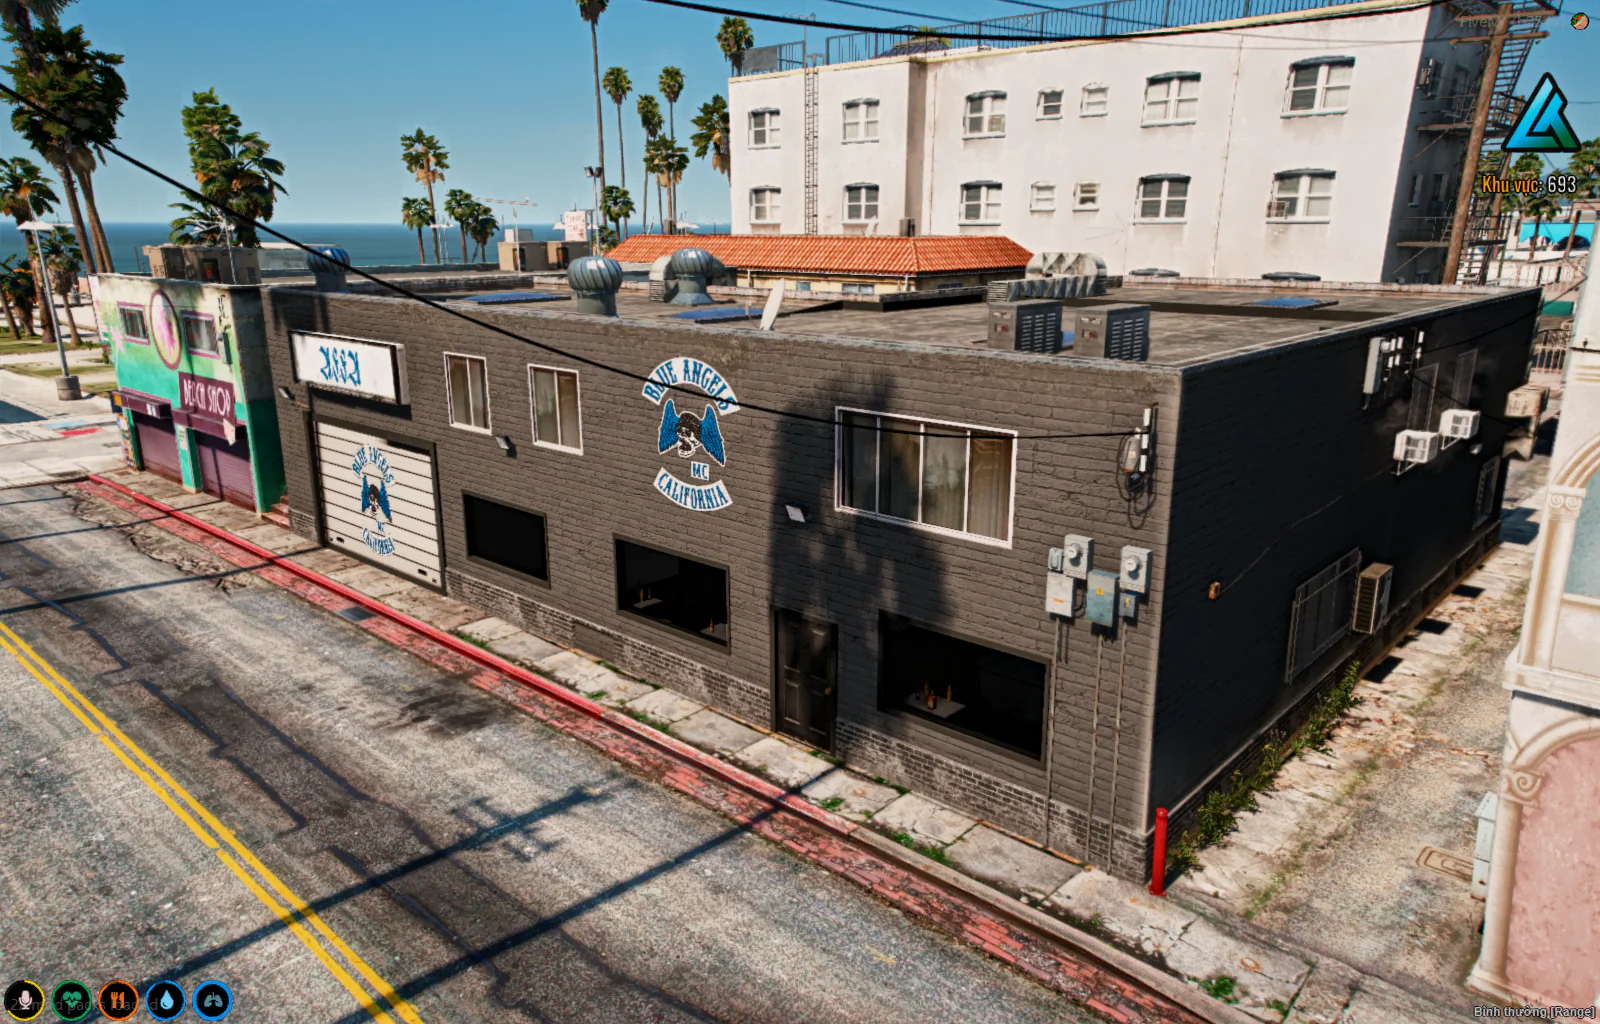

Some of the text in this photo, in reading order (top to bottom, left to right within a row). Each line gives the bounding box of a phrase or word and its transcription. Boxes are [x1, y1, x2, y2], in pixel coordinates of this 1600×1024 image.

[207, 384, 231, 417] SHOP
[643, 359, 737, 411] BLUE ANGELS
[692, 462, 709, 480] MC
[658, 473, 729, 510] CALIFORNIA
